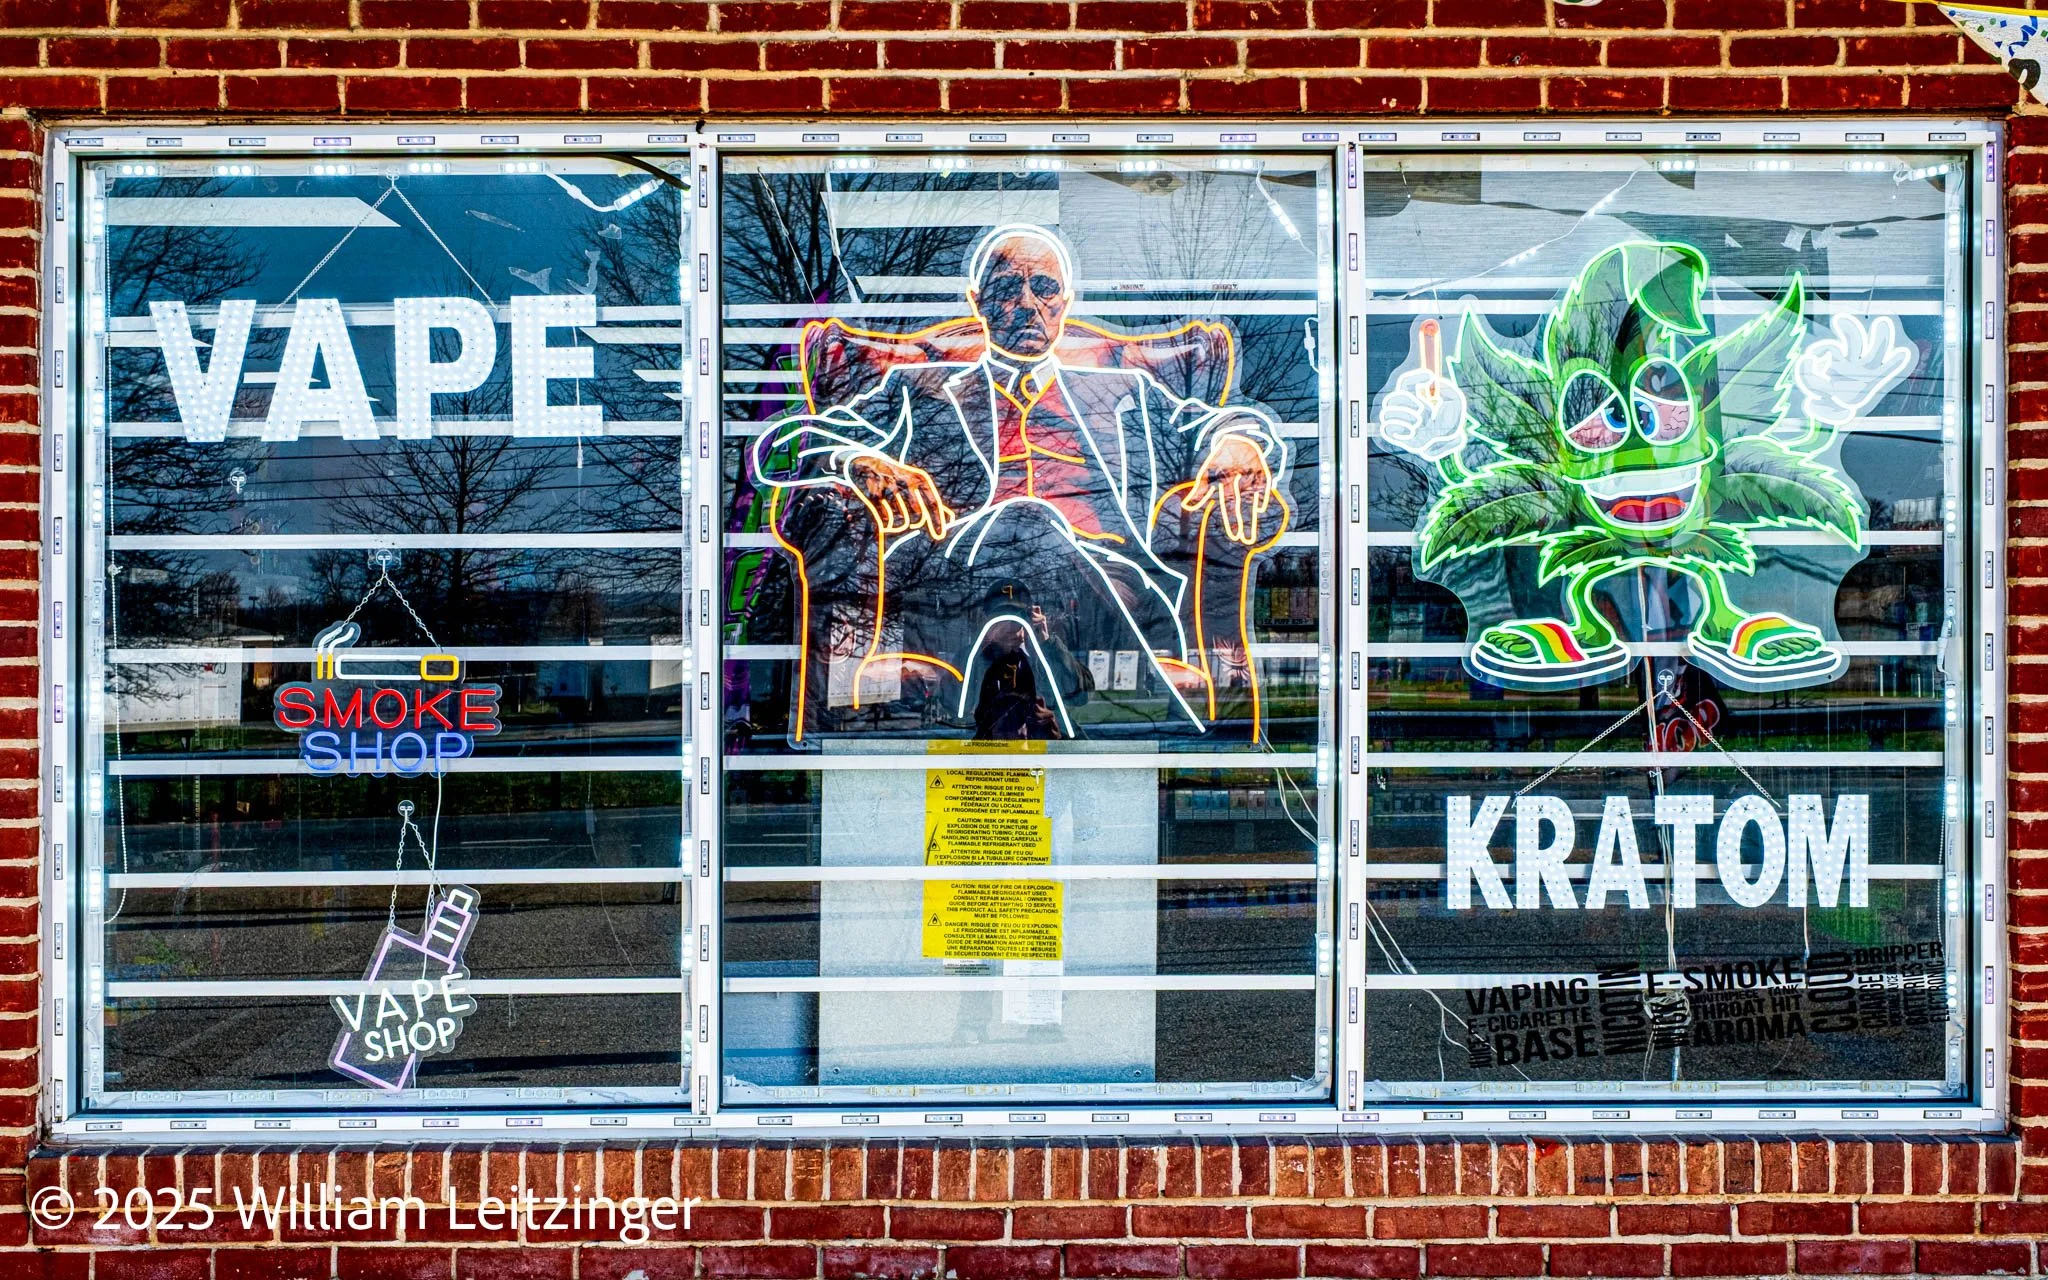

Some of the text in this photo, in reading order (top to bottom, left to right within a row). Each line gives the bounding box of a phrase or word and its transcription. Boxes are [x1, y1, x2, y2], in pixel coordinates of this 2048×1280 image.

[149, 294, 603, 442] VAPE
[278, 687, 497, 730] SMOKE
[304, 731, 467, 772] SHOP
[1447, 794, 1869, 909] KRATOM
[1855, 941, 1944, 965] DRIPPER
[1465, 977, 1590, 1015] VAPING
[1647, 956, 1803, 997] E-SMOKE
[1768, 984, 1799, 997] TANK
[1807, 952, 1858, 1033] CLOUD
[1856, 965, 1888, 1028] CHARGER
[1901, 963, 1929, 1025] BATTERIES
[1925, 960, 1950, 1022] ELECTRONIC
[336, 973, 469, 1032] VAPE
[1467, 1007, 1593, 1034] E-CIGARETTE
[1595, 962, 1648, 1055] NICOTIN
[1693, 993, 1803, 1020] THROAT HIT
[364, 1017, 456, 1061] SHOP
[1494, 1025, 1599, 1066] BASE
[1693, 1012, 1807, 1047] AROMA
